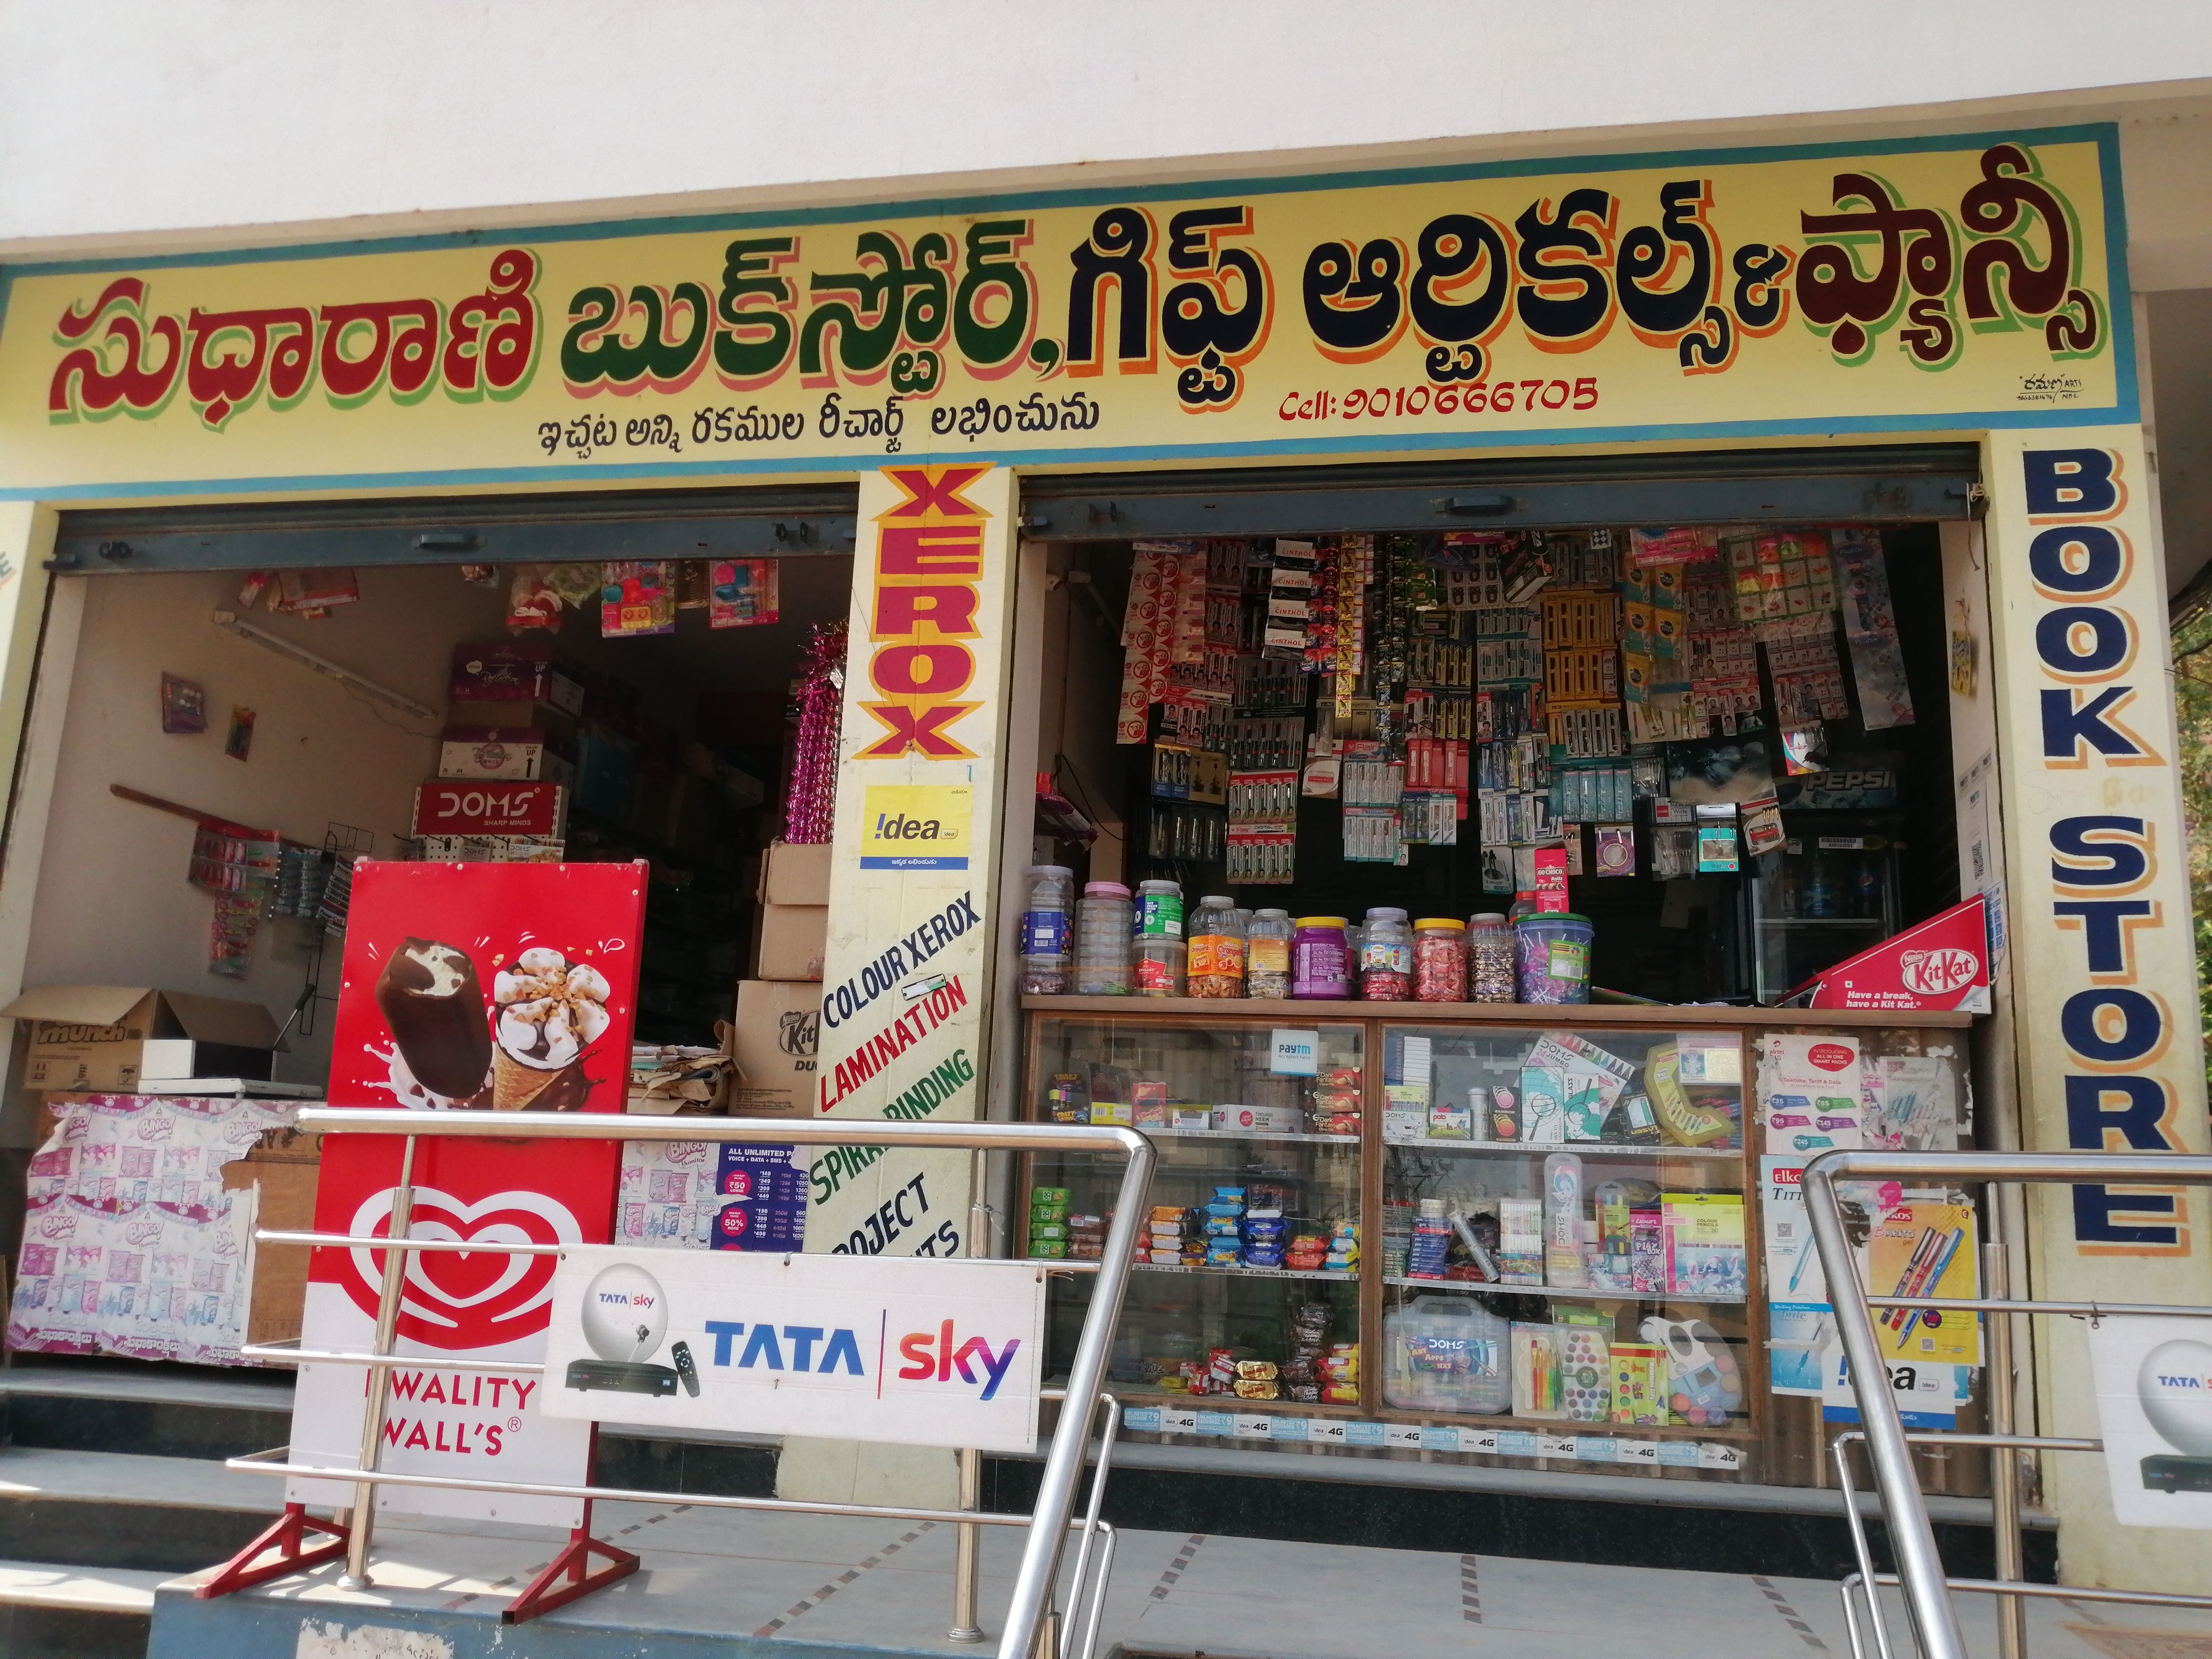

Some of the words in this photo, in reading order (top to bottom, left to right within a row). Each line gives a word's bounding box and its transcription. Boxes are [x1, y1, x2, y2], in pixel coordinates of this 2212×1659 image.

[49, 249, 541, 434] సుధారాణి
[539, 413, 617, 459] ఇచ్చట
[625, 408, 682, 452] అన్ని
[692, 406, 805, 444] రకముల
[932, 392, 1099, 447] లభించును
[1281, 549, 1312, 557] CINTHOL
[851, 461, 997, 760] XEROX
[1276, 608, 1305, 616] CINTHOL
[2022, 448, 2167, 771] BOOK
[1271, 638, 1302, 646] CINTHOL
[1806, 770, 1892, 791] PEPSI
[438, 792, 534, 817] DOMS
[824, 945, 905, 1028] COLOUR
[900, 890, 982, 971] XEROX
[1846, 1000, 1871, 1008] have
[1848, 991, 1872, 999] Have
[1893, 992, 1914, 1000] break,
[820, 975, 969, 1112] LAMINATION
[2048, 814, 2191, 1256] STORE
[1279, 1044, 1311, 1054] paytm
[1536, 1049, 1544, 1058] 24
[1546, 1052, 1569, 1068] JUMBO
[1540, 1039, 1574, 1061] DOMS
[141, 1116, 175, 1136] BINGO!
[228, 1117, 262, 1137] BINGO!
[810, 1146, 891, 1205] SPIRA
[44, 1214, 79, 1235] BINGO!
[129, 1220, 165, 1241] BINGO!
[1634, 1241, 1658, 1252] PLAY
[600, 1293, 627, 1304] TATA
[633, 1294, 655, 1309] sky
[1429, 1339, 1464, 1350] DOMS
[705, 1320, 865, 1377] TATA
[898, 1319, 1021, 1401] sky
[2158, 1375, 2200, 1388] TATA
[382, 1417, 503, 1456] WALL'S
[1404, 1432, 1420, 1441] 4G
[1479, 1438, 1495, 1447] 4G
[1558, 1443, 1574, 1452] 4G
[1638, 1448, 1655, 1457] 4G
